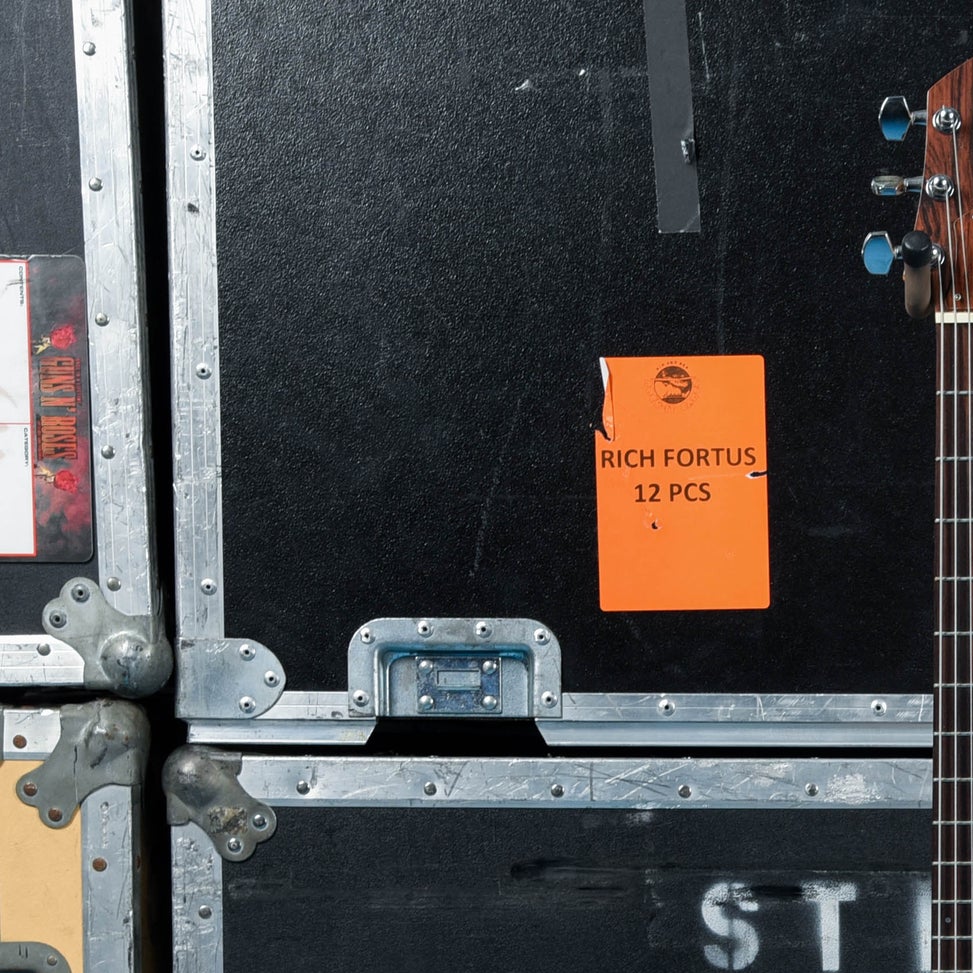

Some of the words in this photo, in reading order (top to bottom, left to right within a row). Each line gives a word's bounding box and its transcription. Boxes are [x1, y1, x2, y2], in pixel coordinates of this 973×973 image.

[39, 356, 75, 392] GUNS
[41, 415, 77, 459] ROSES
[601, 449, 655, 468] RICH
[664, 447, 757, 467] FORTUS
[634, 483, 661, 503] 12
[669, 482, 711, 502] PCS
